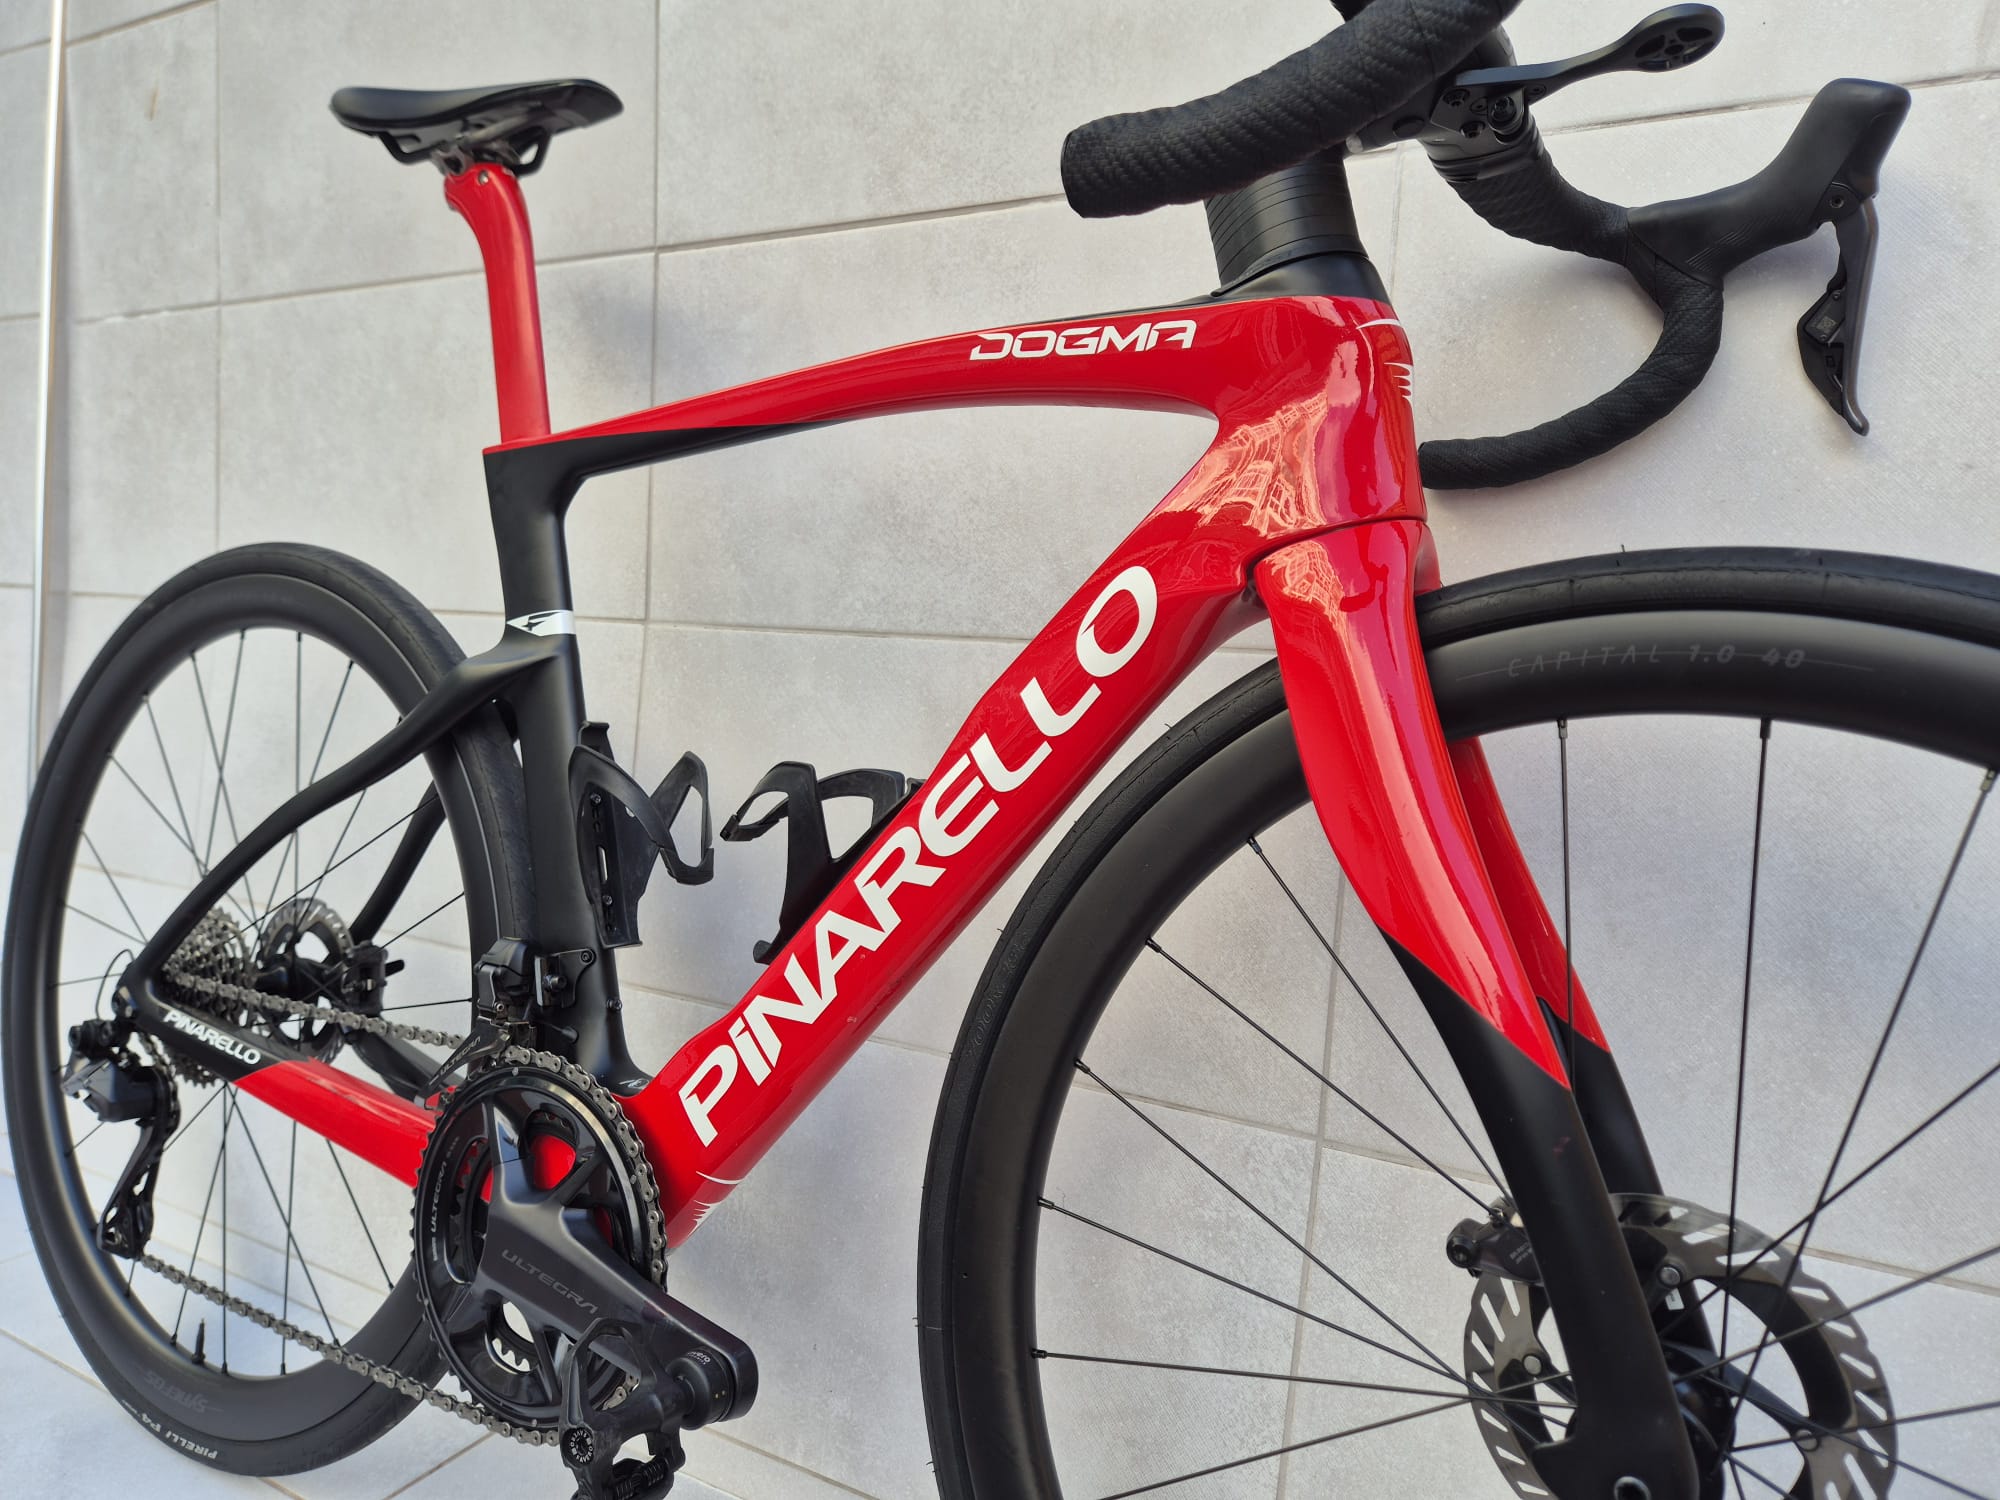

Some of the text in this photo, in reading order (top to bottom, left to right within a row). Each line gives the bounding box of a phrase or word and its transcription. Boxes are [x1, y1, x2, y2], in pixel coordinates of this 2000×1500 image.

[969, 319, 1197, 361] DOGMA
[1508, 644, 1806, 678] CAPITAL 1.0 40
[677, 565, 1158, 1148] PINARELLO
[163, 1009, 261, 1065] PINARELLO
[430, 1160, 447, 1233] ULTEGRA
[501, 1249, 599, 1315] ULTEGRA
[165, 1430, 218, 1460] PIRELLI
